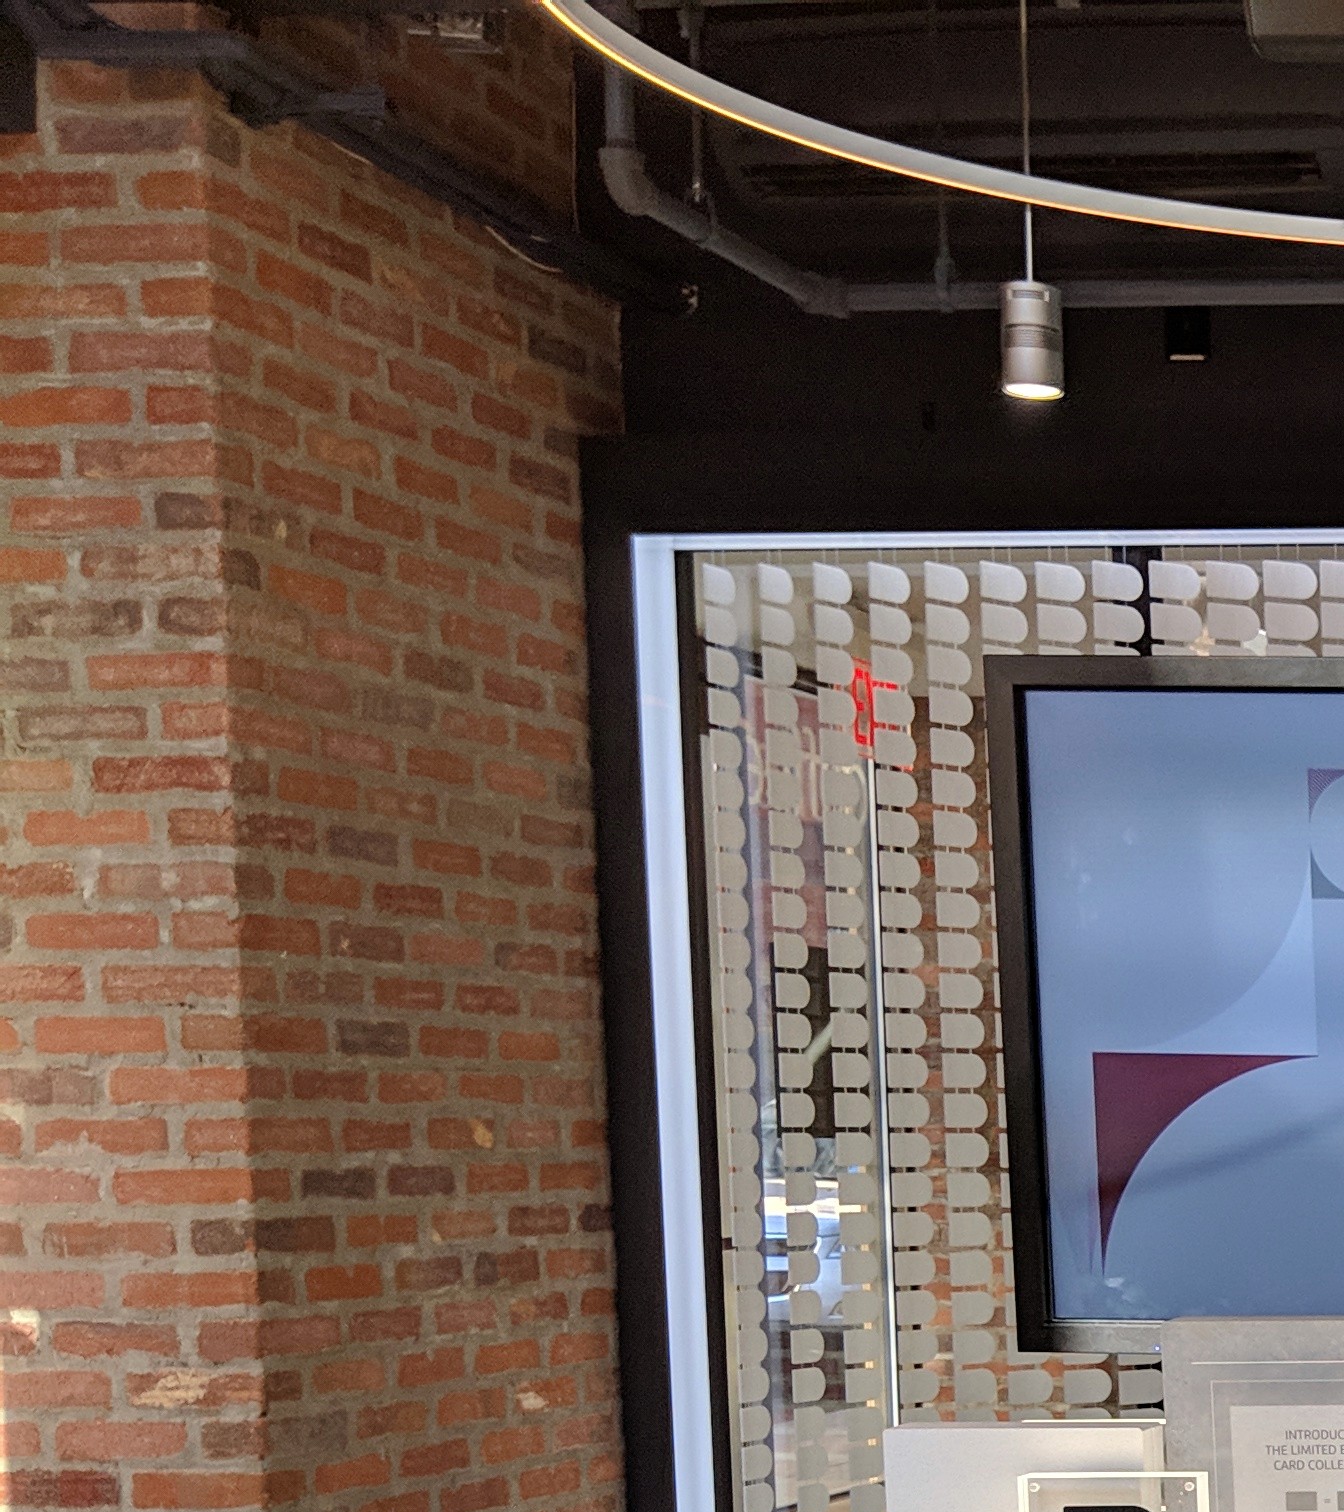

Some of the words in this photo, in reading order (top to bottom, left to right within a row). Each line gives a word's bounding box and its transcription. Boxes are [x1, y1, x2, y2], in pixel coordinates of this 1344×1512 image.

[1265, 1445, 1287, 1456] THE
[1290, 1444, 1338, 1456] LIMITED
[1273, 1460, 1305, 1471] CARD
